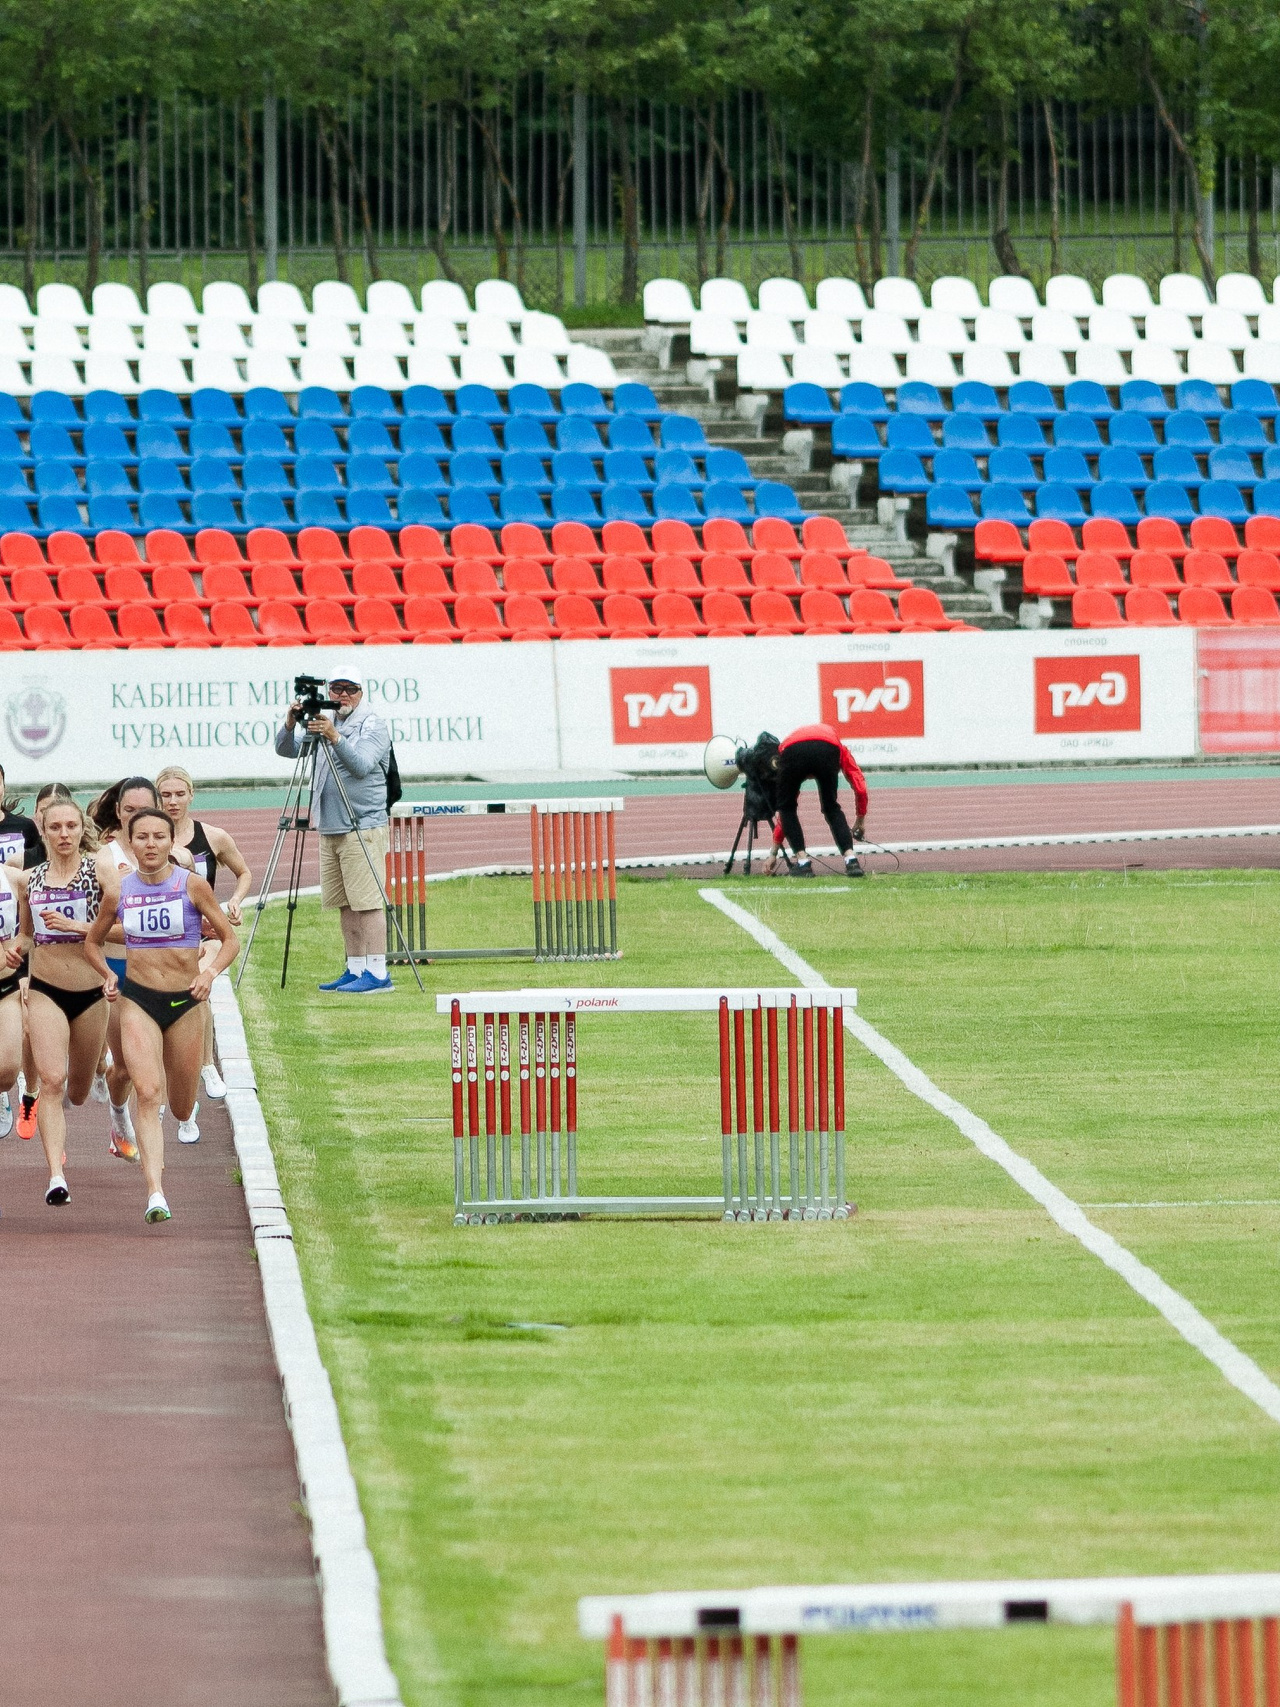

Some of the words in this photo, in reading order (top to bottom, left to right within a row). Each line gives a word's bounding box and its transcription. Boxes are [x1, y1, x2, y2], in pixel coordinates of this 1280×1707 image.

[110, 681, 238, 709] КАБИНЕТ
[247, 678, 420, 707] МИРОВ
[413, 805, 465, 815] POLANIK
[138, 908, 171, 932] 156
[576, 998, 619, 1009] polanik
